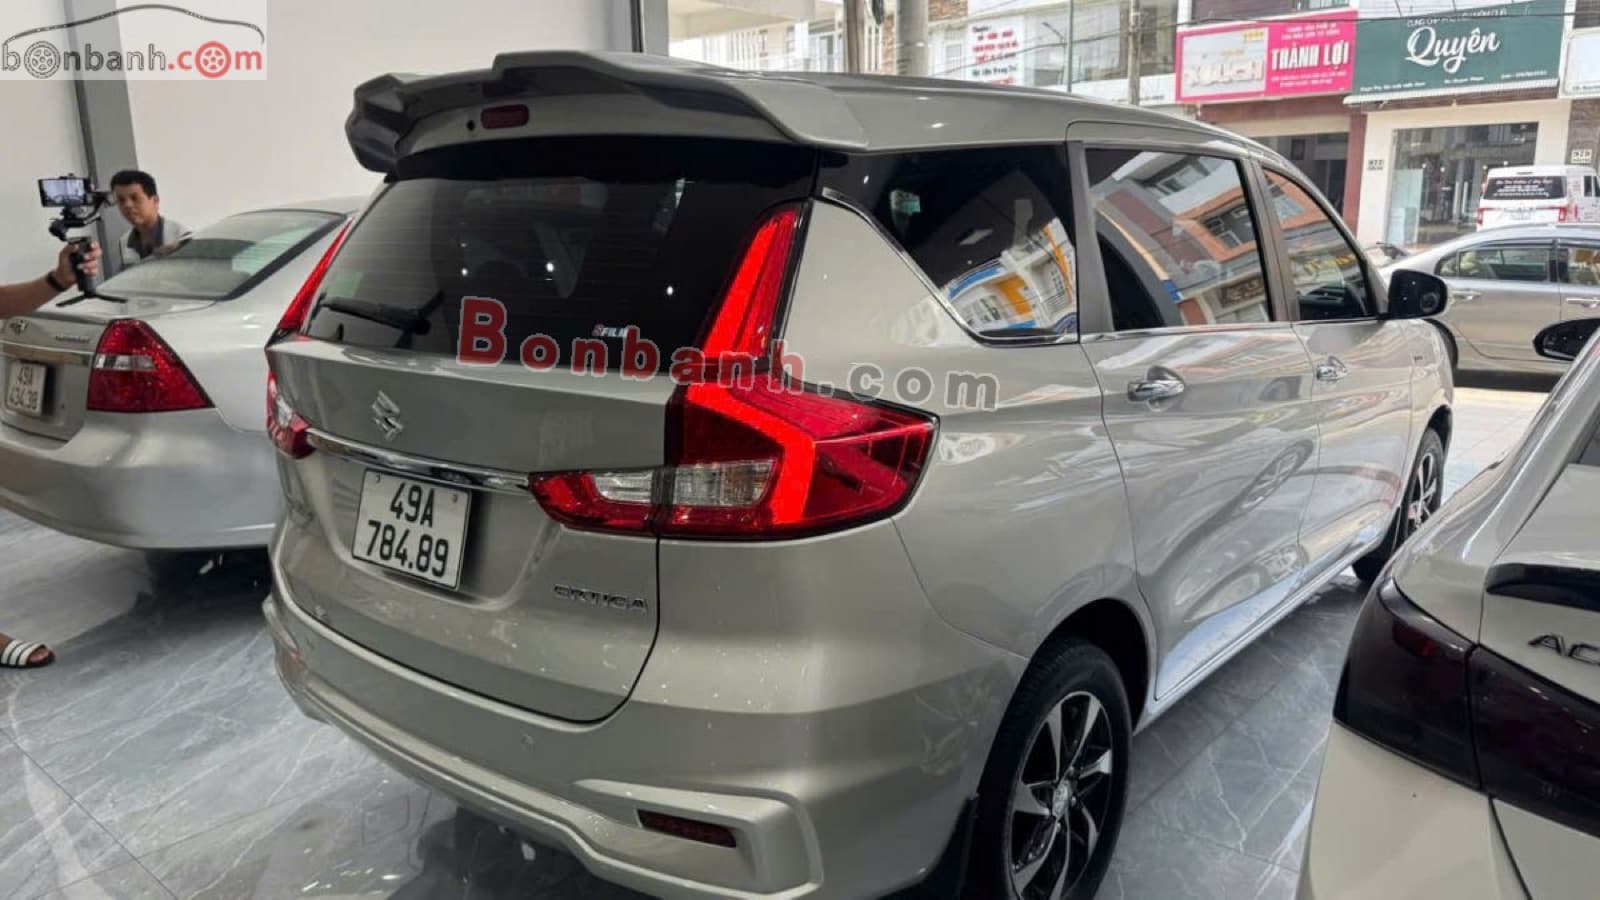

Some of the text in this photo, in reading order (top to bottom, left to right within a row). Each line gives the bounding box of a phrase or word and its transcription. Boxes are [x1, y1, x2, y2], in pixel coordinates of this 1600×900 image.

[1271, 40, 1350, 71] THÀNH LỢI
[1404, 26, 1501, 74] Quyên
[389, 481, 436, 529] 49A
[365, 519, 450, 578] 784.89
